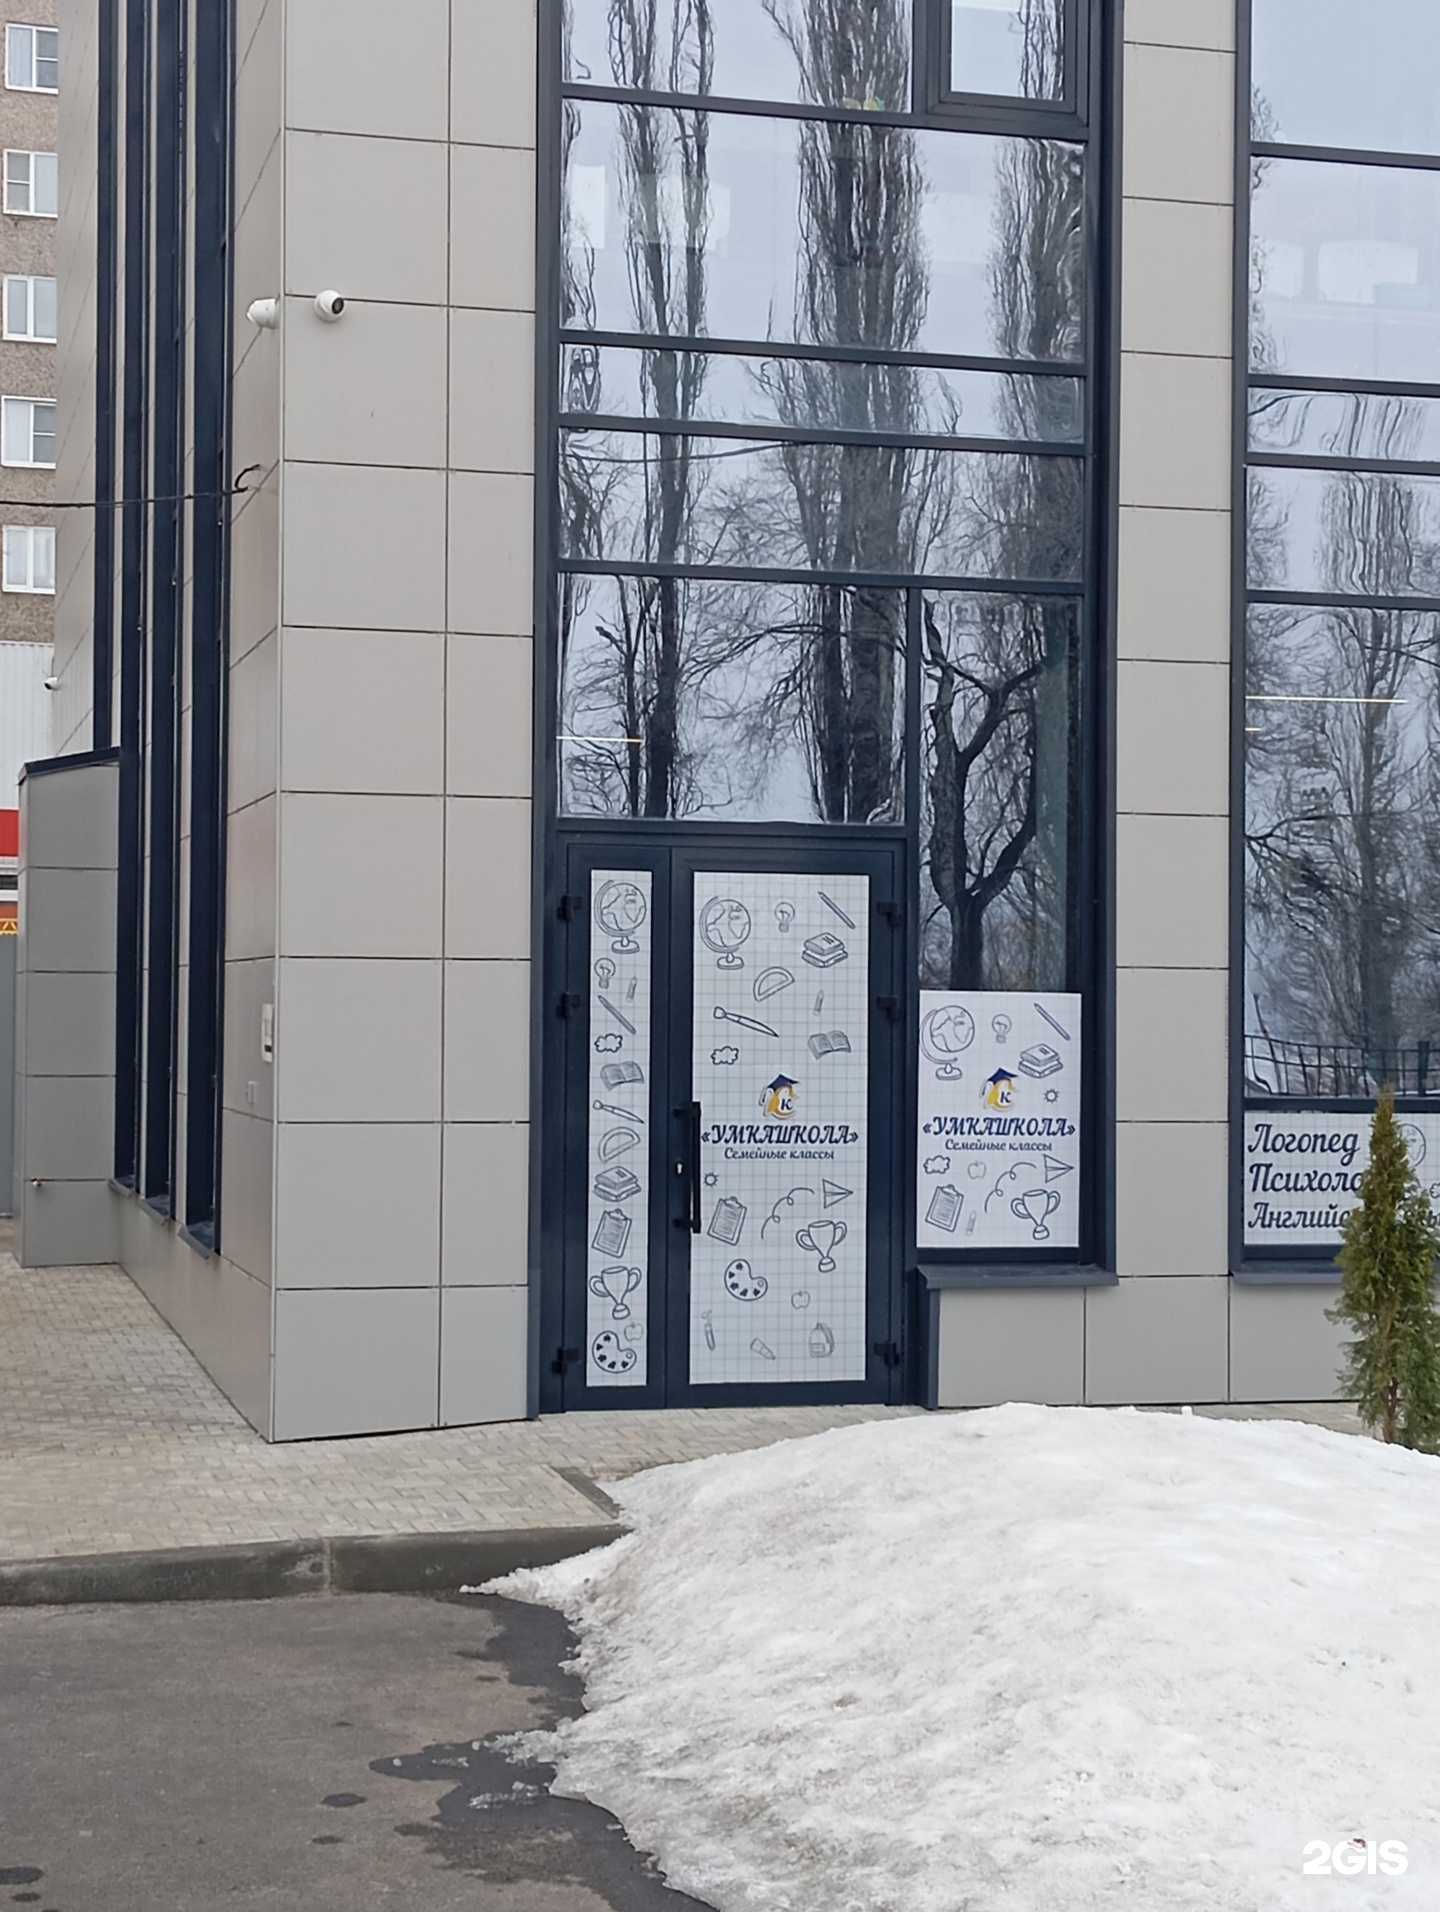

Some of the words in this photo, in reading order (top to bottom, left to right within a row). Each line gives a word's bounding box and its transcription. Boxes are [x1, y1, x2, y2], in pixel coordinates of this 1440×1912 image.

[701, 1124, 859, 1144] «УМКАШКОЛА»
[922, 1116, 1076, 1136] «УМКАШКОЛА»
[724, 1146, 787, 1160] Семейные
[789, 1148, 835, 1160] классы
[945, 1138, 1006, 1151] Семейные
[1009, 1141, 1053, 1152] классы
[1248, 1123, 1360, 1166] Логопед
[1249, 1163, 1364, 1192] Психоло
[1248, 1202, 1350, 1228] Английс
